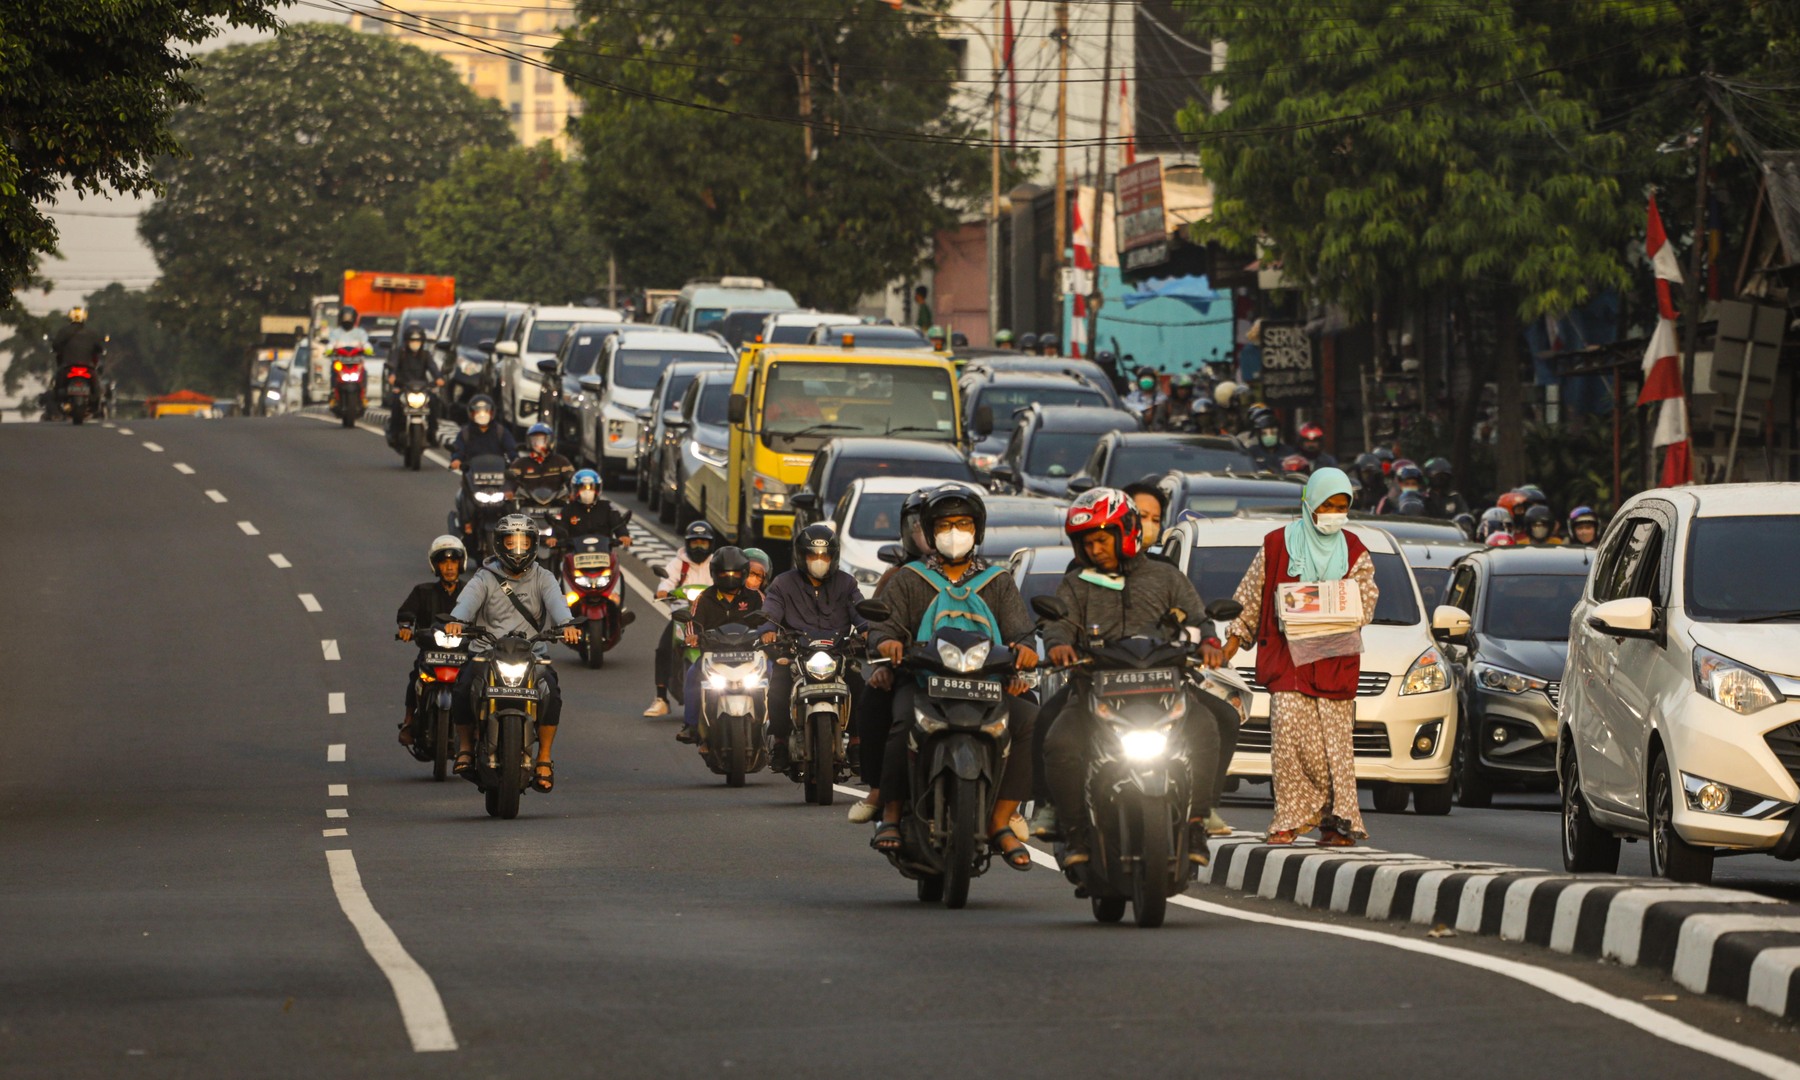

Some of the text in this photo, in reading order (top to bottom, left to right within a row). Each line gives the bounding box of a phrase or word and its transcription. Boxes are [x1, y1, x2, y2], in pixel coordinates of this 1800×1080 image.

[1338, 580, 1348, 611] erdeka
[931, 678, 1000, 692] B 6826 PMN
